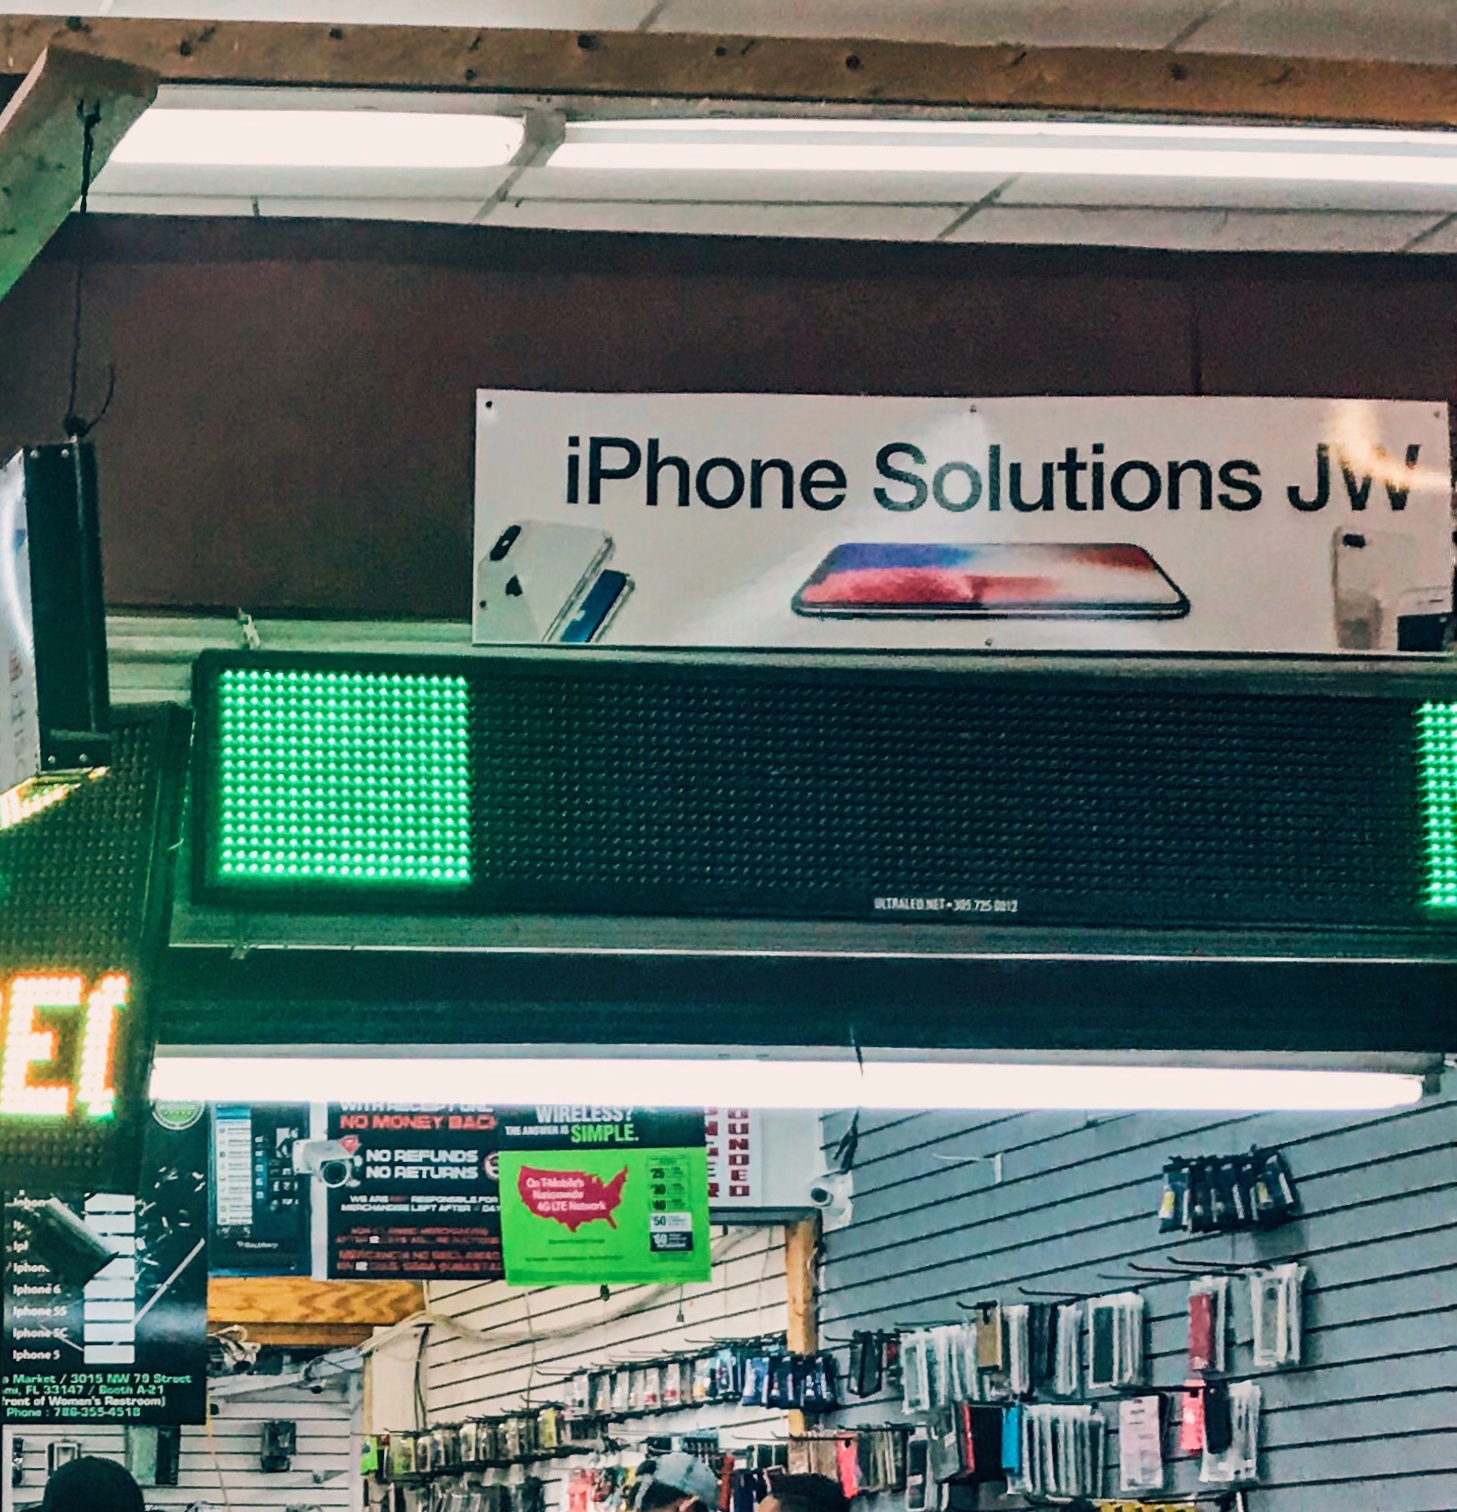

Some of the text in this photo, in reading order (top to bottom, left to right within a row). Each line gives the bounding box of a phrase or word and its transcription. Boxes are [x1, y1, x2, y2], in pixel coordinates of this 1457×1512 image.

[566, 435, 1422, 514] iPhone Solutions JW
[535, 1104, 633, 1124] WIRELESS?
[339, 1115, 368, 1129] NO
[372, 1115, 443, 1129] MONEY
[505, 1125, 522, 1136] THE
[571, 1123, 639, 1143] SIMPLE.
[366, 1149, 479, 1163] NO REFUNDS
[366, 1166, 479, 1179] NO RETURNS
[12, 1283, 61, 1295] Iphone 6
[12, 1305, 51, 1317] Iphone
[12, 1327, 51, 1339] Iphone
[12, 1349, 61, 1360] Iphone 5
[13, 1373, 57, 1384] Market
[70, 1373, 103, 1384] 3015
[107, 1373, 131, 1384] NW
[153, 1373, 192, 1384] Street
[25, 1384, 40, 1395] FL
[43, 1384, 83, 1395] 33147
[98, 1384, 134, 1395] Booth
[33, 1395, 46, 1406] of
[6, 1407, 42, 1417] Phone
